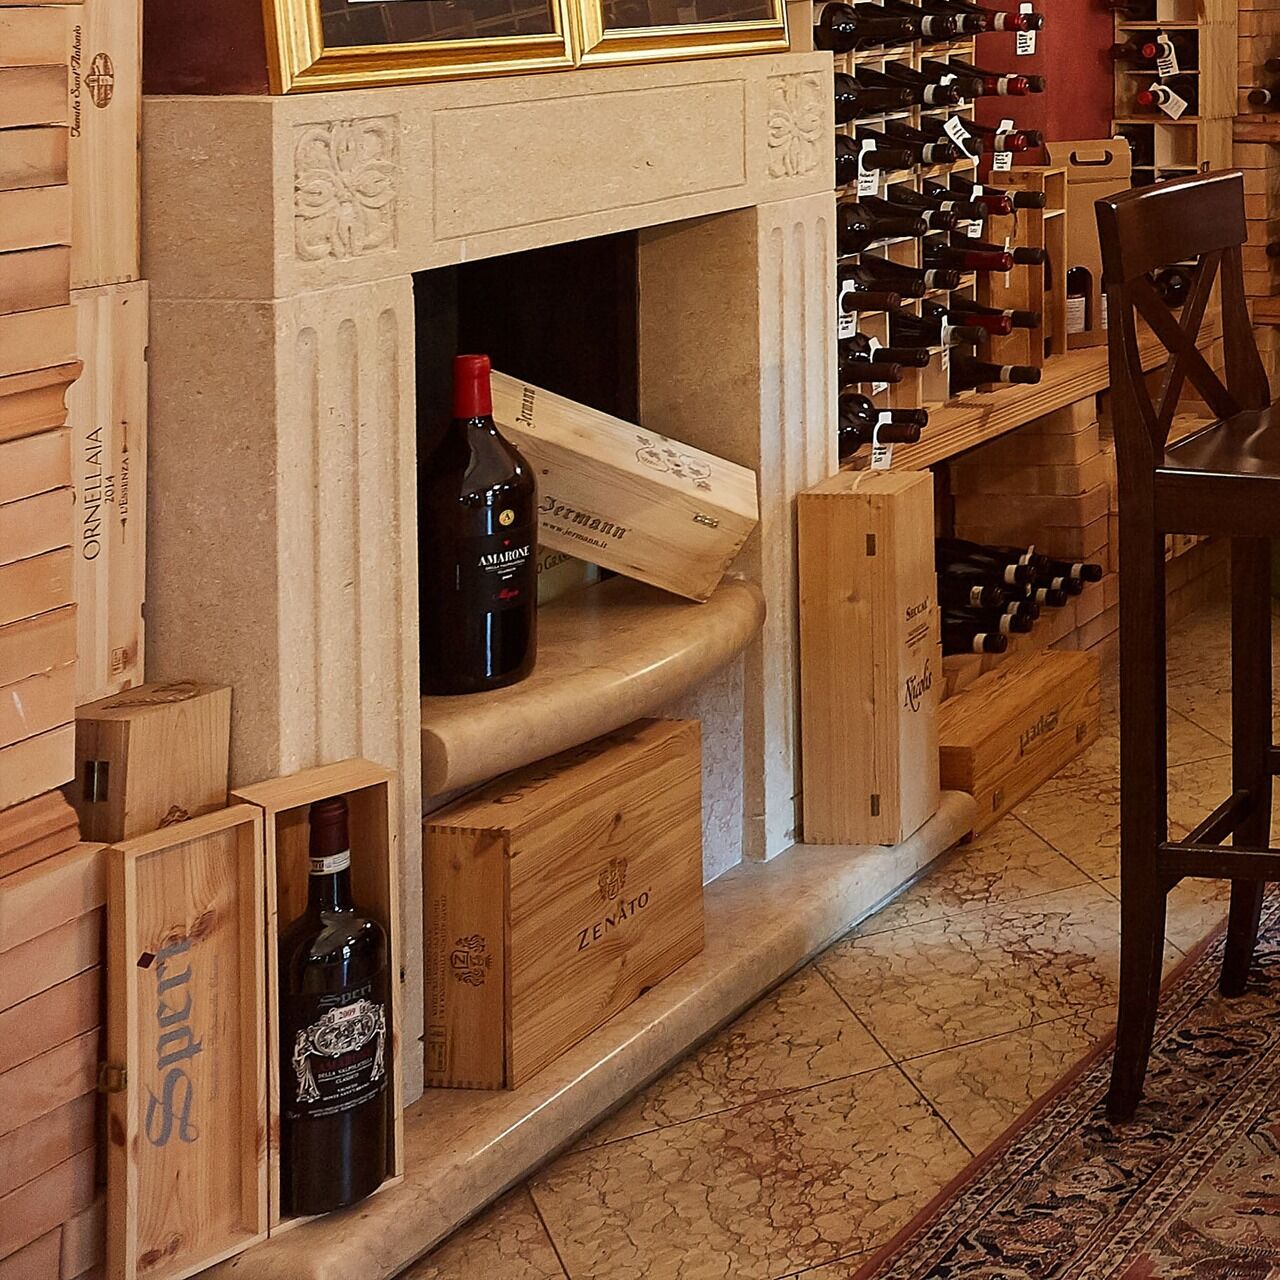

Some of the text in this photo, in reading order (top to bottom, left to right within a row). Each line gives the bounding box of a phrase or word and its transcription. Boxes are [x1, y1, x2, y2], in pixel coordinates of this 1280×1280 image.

[82, 426, 103, 560] ORNELLAIA
[104, 474, 115, 504] 2014
[537, 495, 627, 541] Jermann
[541, 521, 608, 549] www.jermann.it
[478, 544, 531, 568] AMARONE
[576, 891, 650, 952] ZENATO
[137, 939, 203, 1148] Speri
